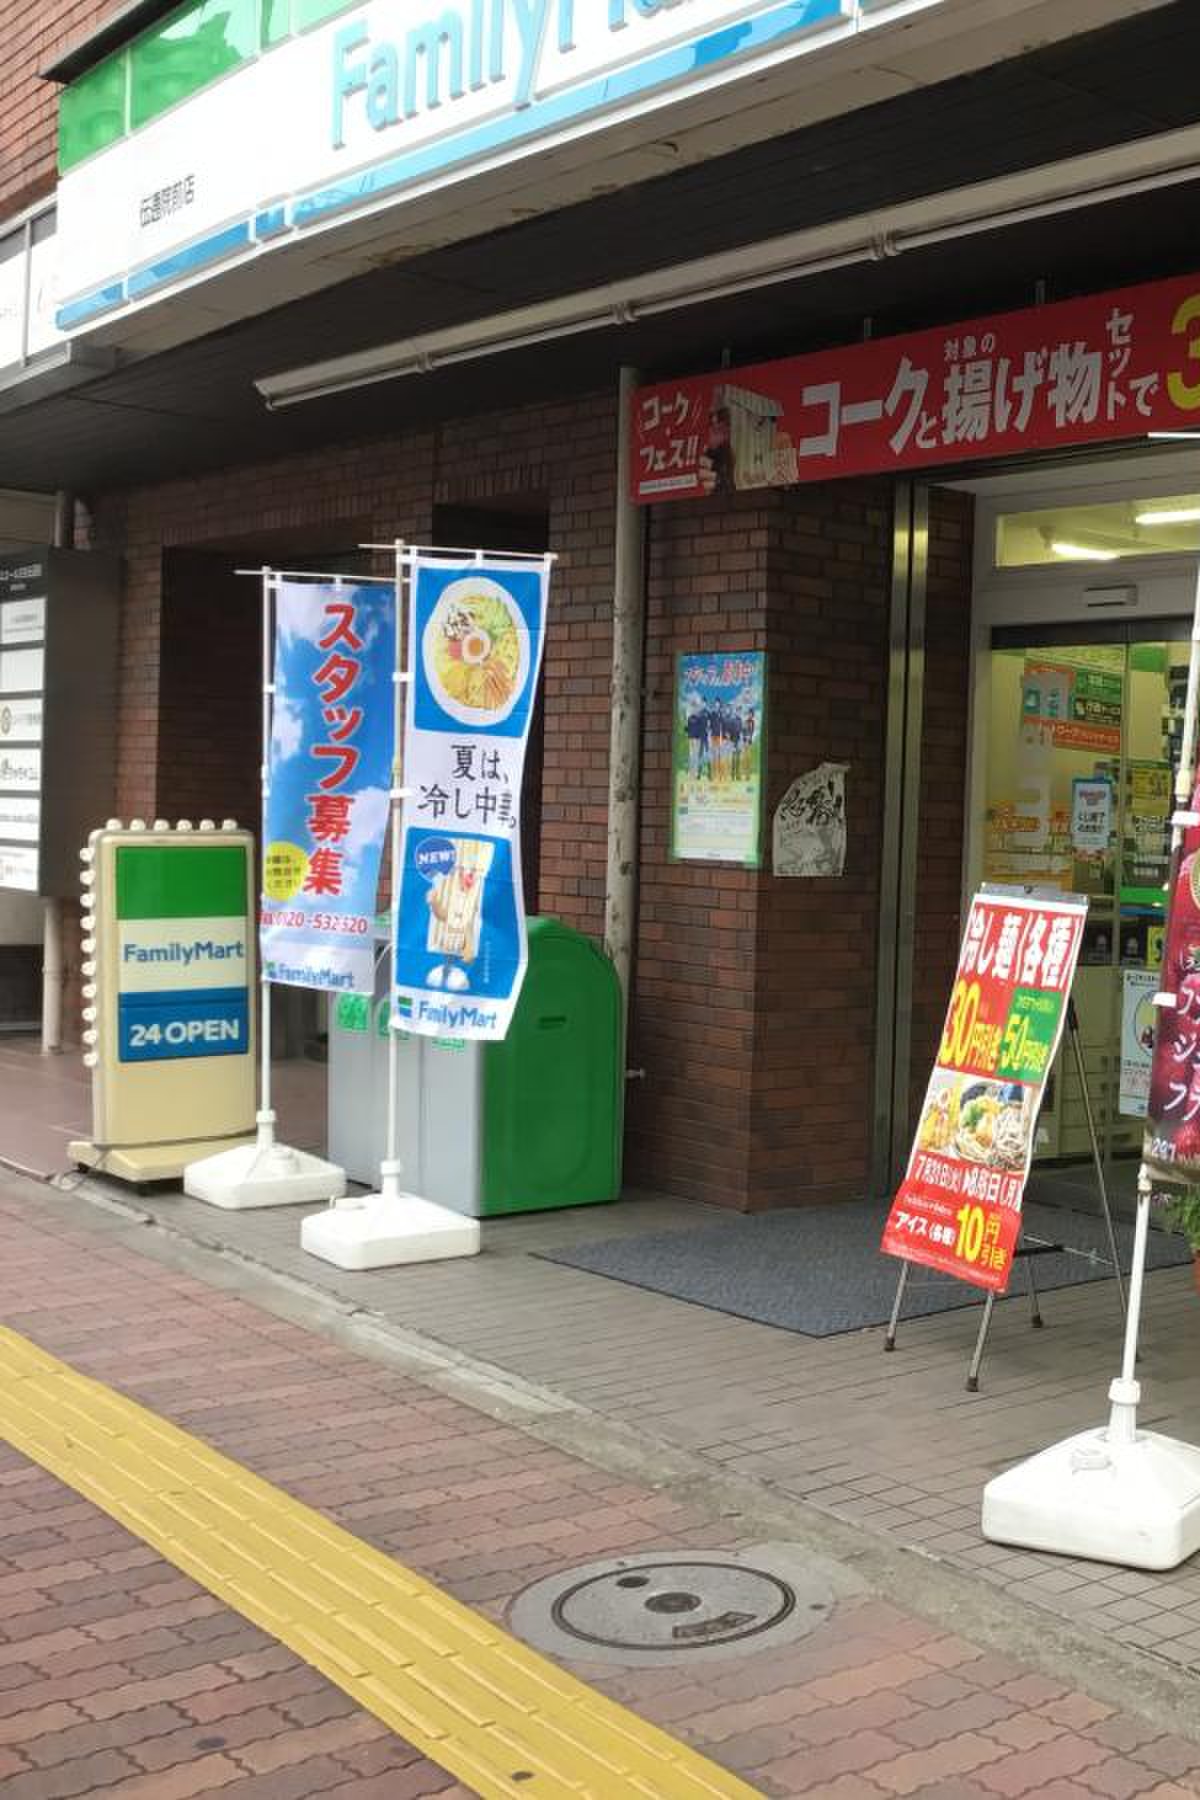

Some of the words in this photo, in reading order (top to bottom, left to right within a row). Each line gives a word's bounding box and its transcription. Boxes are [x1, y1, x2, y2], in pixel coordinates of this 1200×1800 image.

[1105, 307, 1134, 421] セット
[303, 602, 364, 896] スタッフ募集
[451, 744, 509, 784] 夏は、
[123, 941, 244, 965] FamilyMart
[129, 1023, 160, 1047] 24
[164, 1019, 240, 1044] OPEN
[955, 1202, 985, 1262] 10
